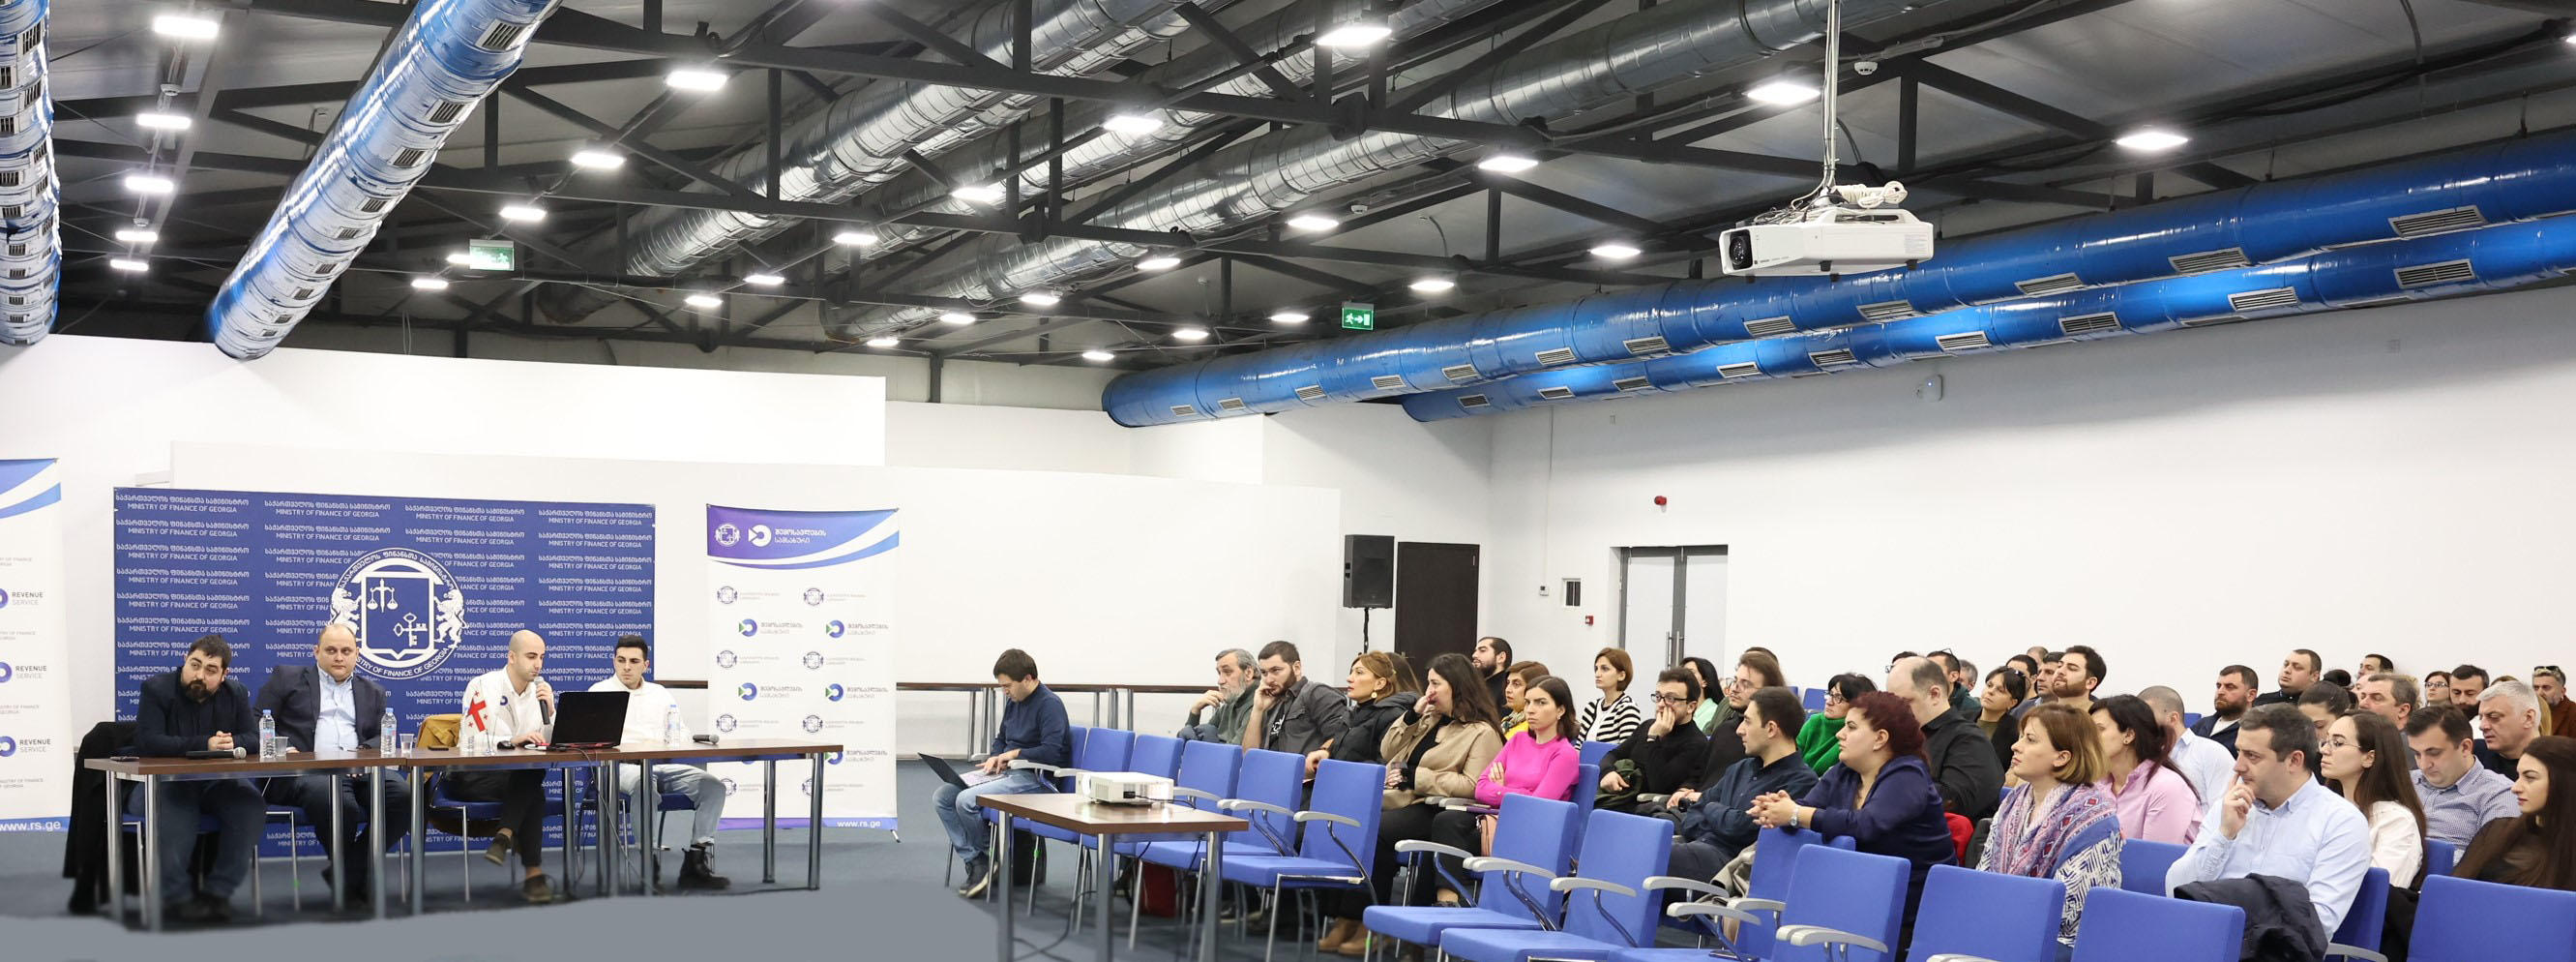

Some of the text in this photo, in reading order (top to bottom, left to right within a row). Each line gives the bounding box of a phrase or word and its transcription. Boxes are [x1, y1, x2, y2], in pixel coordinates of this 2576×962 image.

[373, 666, 383, 675] OF
[383, 668, 413, 677] FINANCE
[413, 665, 424, 675] OF
[424, 647, 450, 670] GEORGIA
[838, 821, 881, 829] www.rs.ge
